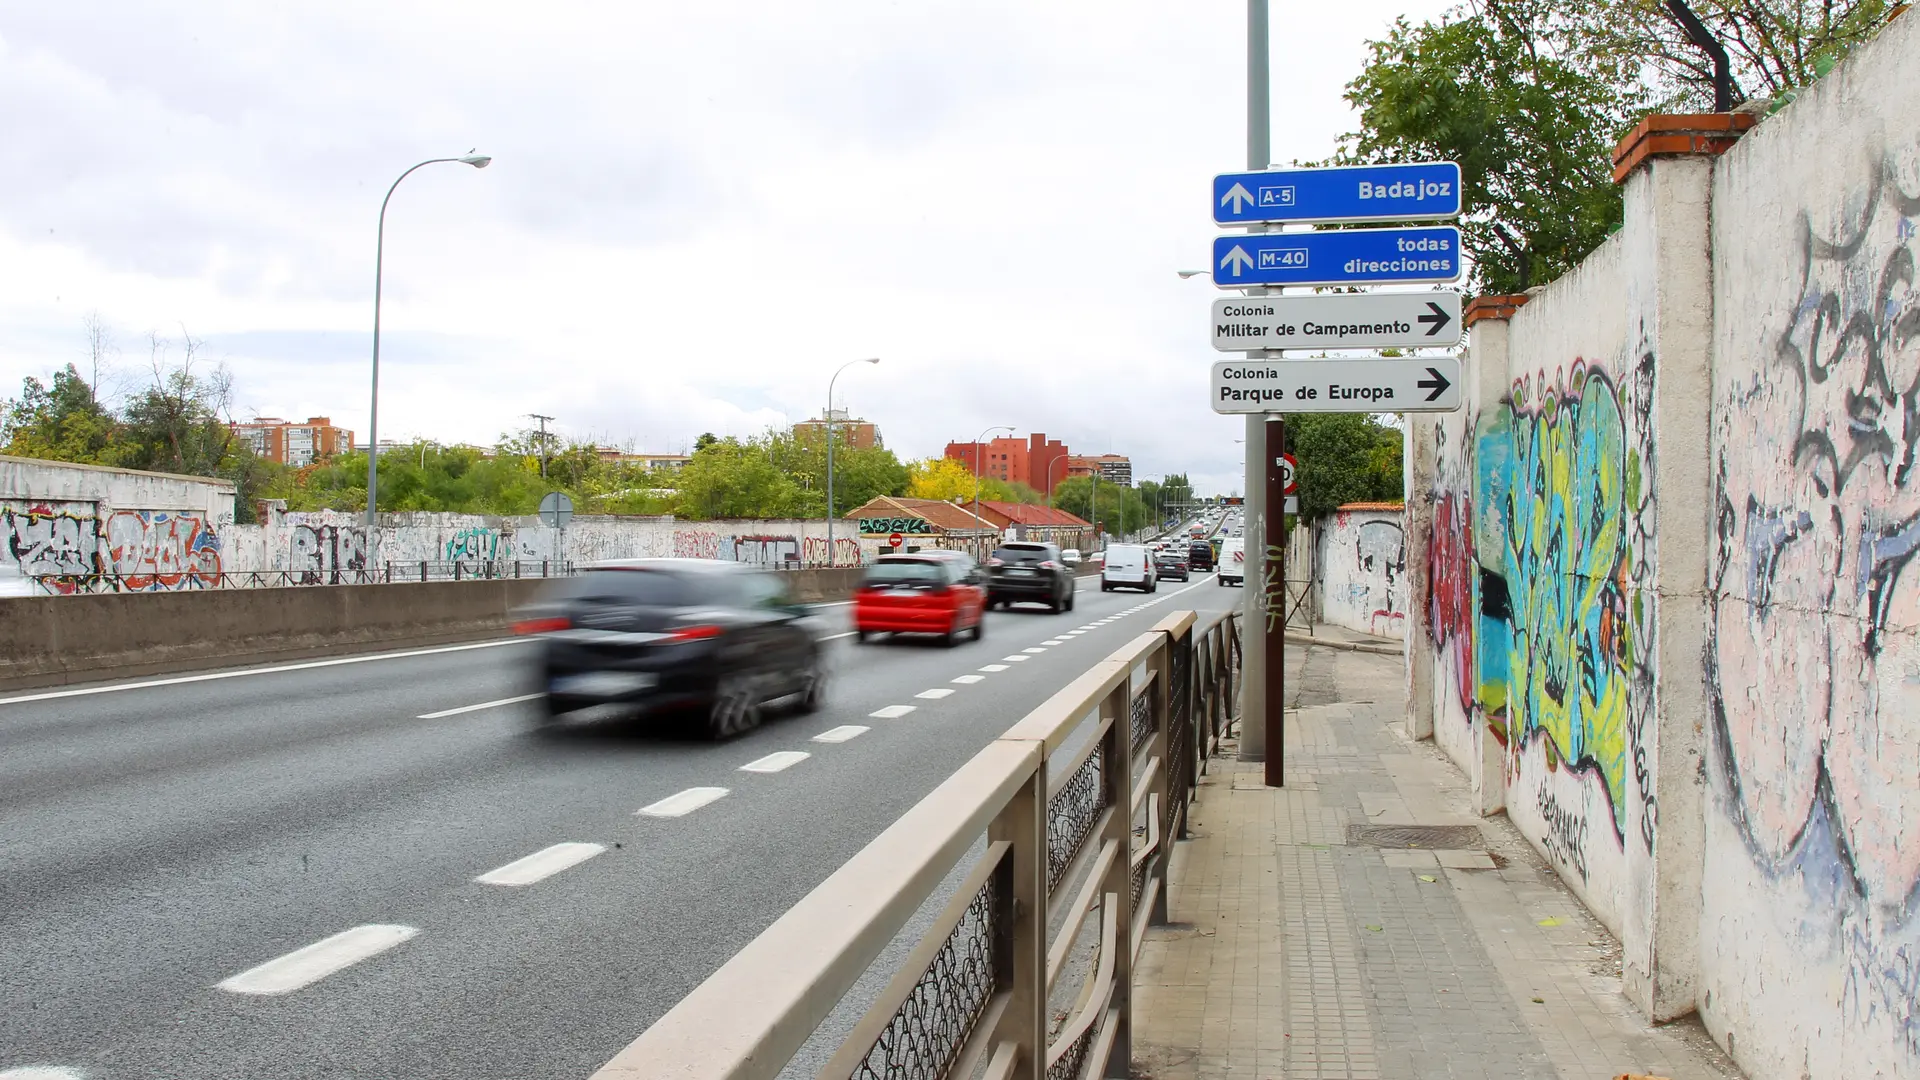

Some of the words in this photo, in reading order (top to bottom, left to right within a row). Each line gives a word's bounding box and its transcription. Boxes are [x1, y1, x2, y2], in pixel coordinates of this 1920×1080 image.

[1263, 189, 1291, 203] A-5
[1359, 179, 1451, 201] Badajoz
[1396, 237, 1450, 252] todas
[1262, 252, 1305, 266] M-40
[1344, 257, 1451, 273] direcciones
[1223, 305, 1275, 317] Colonia
[1217, 323, 1269, 337] Militar
[1275, 323, 1296, 336] de
[1302, 320, 1411, 338] Campamento
[1222, 367, 1278, 380] Colonia
[1220, 386, 1284, 404] Parque
[1295, 386, 1318, 400] de
[1329, 384, 1394, 403] Europa
